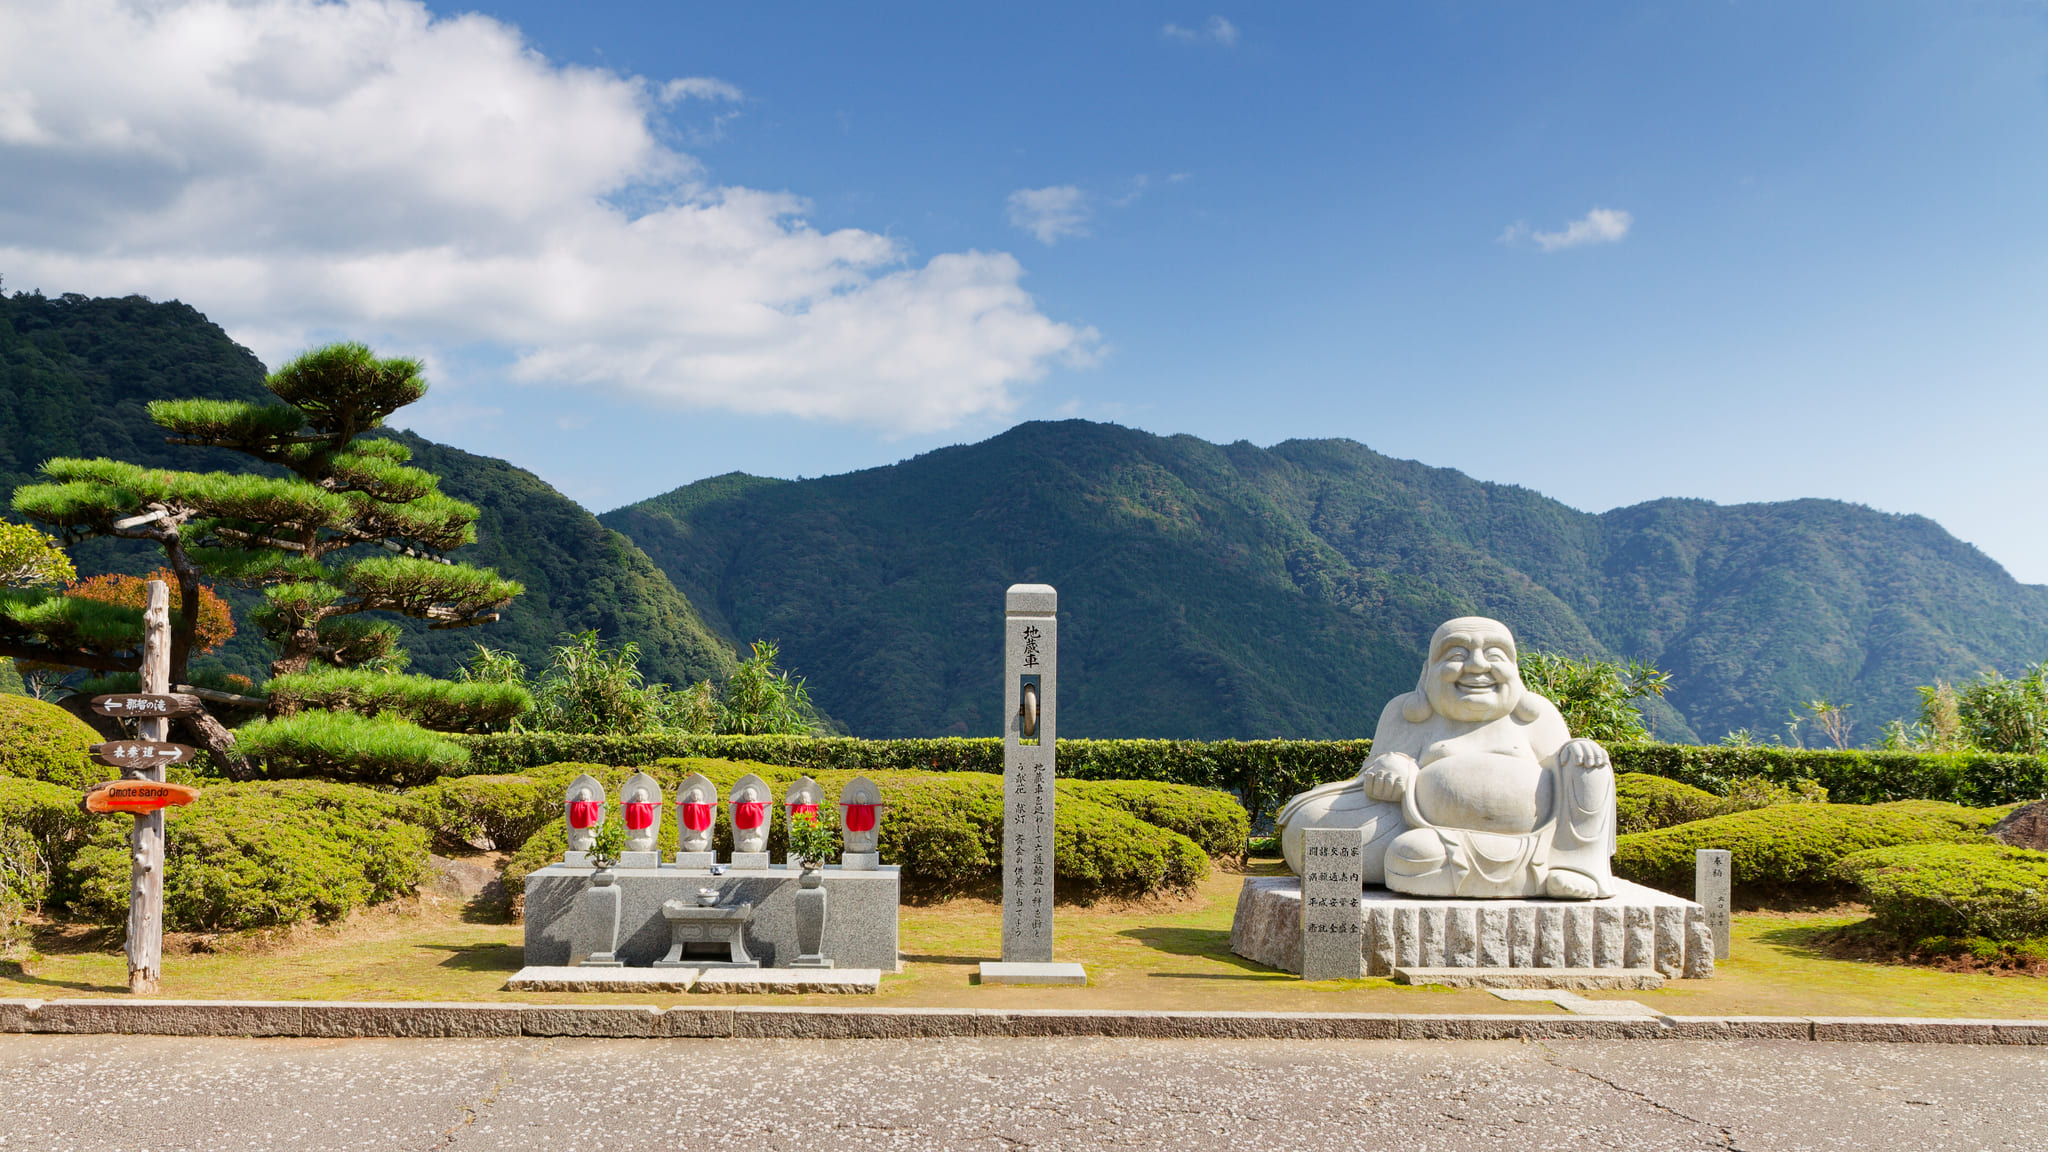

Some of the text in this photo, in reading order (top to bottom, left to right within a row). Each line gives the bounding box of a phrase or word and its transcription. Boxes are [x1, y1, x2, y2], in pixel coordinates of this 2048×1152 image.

[1023, 625, 1041, 668] 地蔵車
[109, 787, 137, 798] Omote
